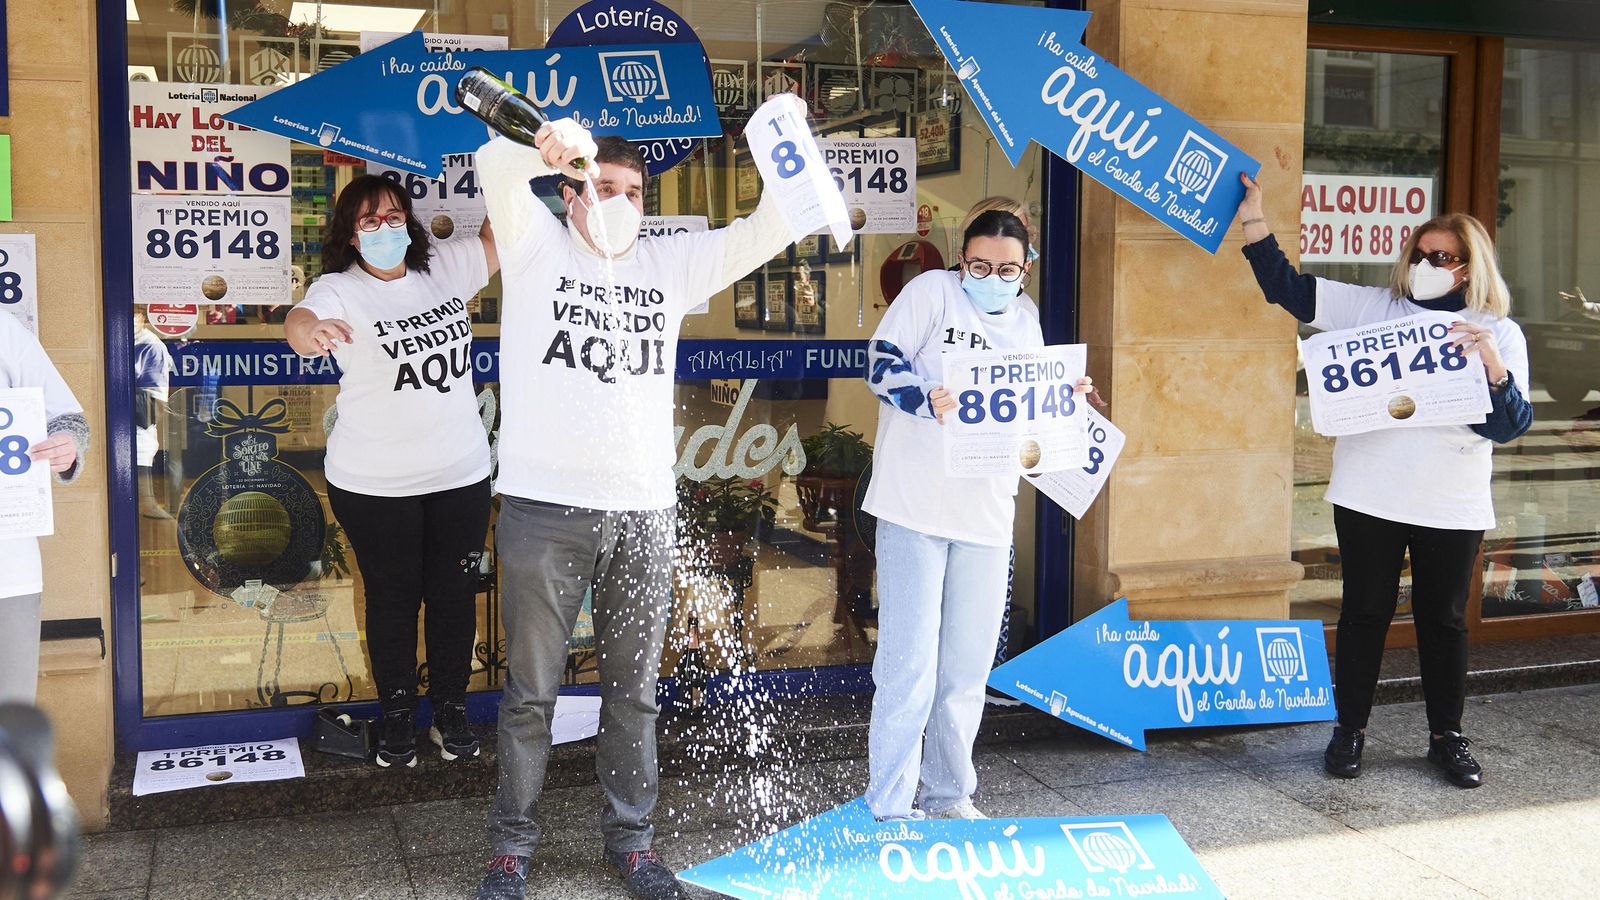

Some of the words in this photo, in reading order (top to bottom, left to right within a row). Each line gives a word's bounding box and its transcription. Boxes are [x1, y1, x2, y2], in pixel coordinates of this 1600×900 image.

[577, 6, 678, 37] Loterías
[1037, 30, 1064, 56] ¡ha
[381, 57, 414, 76] ¡ha
[420, 53, 466, 72] caído
[168, 92, 200, 100] Lotería
[220, 93, 257, 101] Nacional
[417, 52, 577, 141] auí
[939, 26, 960, 57] Loterías
[971, 78, 993, 111] Apuestas
[991, 111, 1002, 124] del
[998, 122, 1014, 147] Estado
[599, 109, 619, 127] de
[623, 105, 702, 128] Navidad!
[1041, 66, 1162, 163] aquí
[192, 135, 232, 152] DEL
[273, 115, 309, 132] Loterías
[310, 128, 317, 136] y
[339, 136, 379, 155] Apuestas
[381, 149, 395, 160] del
[397, 155, 427, 170] Estado
[825, 149, 899, 164] PREMIO
[137, 156, 289, 192] NIÑO
[771, 141, 805, 179] 8
[1088, 148, 1105, 166] el
[1104, 156, 1144, 193] Gordo
[1144, 182, 1160, 203] de
[1161, 191, 1218, 238] Navidad!
[1301, 185, 1425, 215] ALQUILO
[175, 209, 268, 226] PREMIO
[147, 229, 281, 259] 86148
[1299, 224, 1333, 255] 629
[1341, 224, 1363, 255] 16
[1370, 225, 1393, 255] 88
[1400, 225, 1420, 251] 8
[580, 282, 664, 307] PREMIO
[396, 297, 464, 332] PREMIO
[553, 300, 666, 333] VENDIDO
[1356, 325, 1392, 337] VENDIDO
[1394, 320, 1414, 329] AQUÍ
[944, 327, 965, 344] 1er
[1346, 323, 1448, 357] PREMIO
[393, 343, 471, 393] AQU
[542, 330, 665, 383] AQUÍ
[1003, 353, 1034, 361] VENDIDO
[1322, 341, 1468, 393] 86148
[990, 361, 1065, 385] PREMIO
[711, 383, 739, 404] NIÑO
[958, 383, 1076, 424] 86148
[233, 442, 269, 459] SORTEO
[1096, 622, 1121, 644] ¡ha
[1125, 621, 1160, 642] caído
[1123, 625, 1243, 723] aquí
[1016, 680, 1043, 699] Loterías
[1066, 706, 1097, 727] Apuestas
[1097, 723, 1109, 733] del
[1109, 729, 1133, 745] Estado
[1197, 691, 1209, 712] el
[1214, 690, 1256, 711] Gordo
[1259, 688, 1274, 709] de
[1275, 687, 1330, 710] Navidad!
[150, 750, 286, 771] 86148
[180, 744, 273, 758] PREMIO
[879, 824, 1046, 900] aquí
[1018, 879, 1083, 899] Gordo
[1086, 877, 1111, 897] de
[1109, 872, 1202, 897] Navidad!
